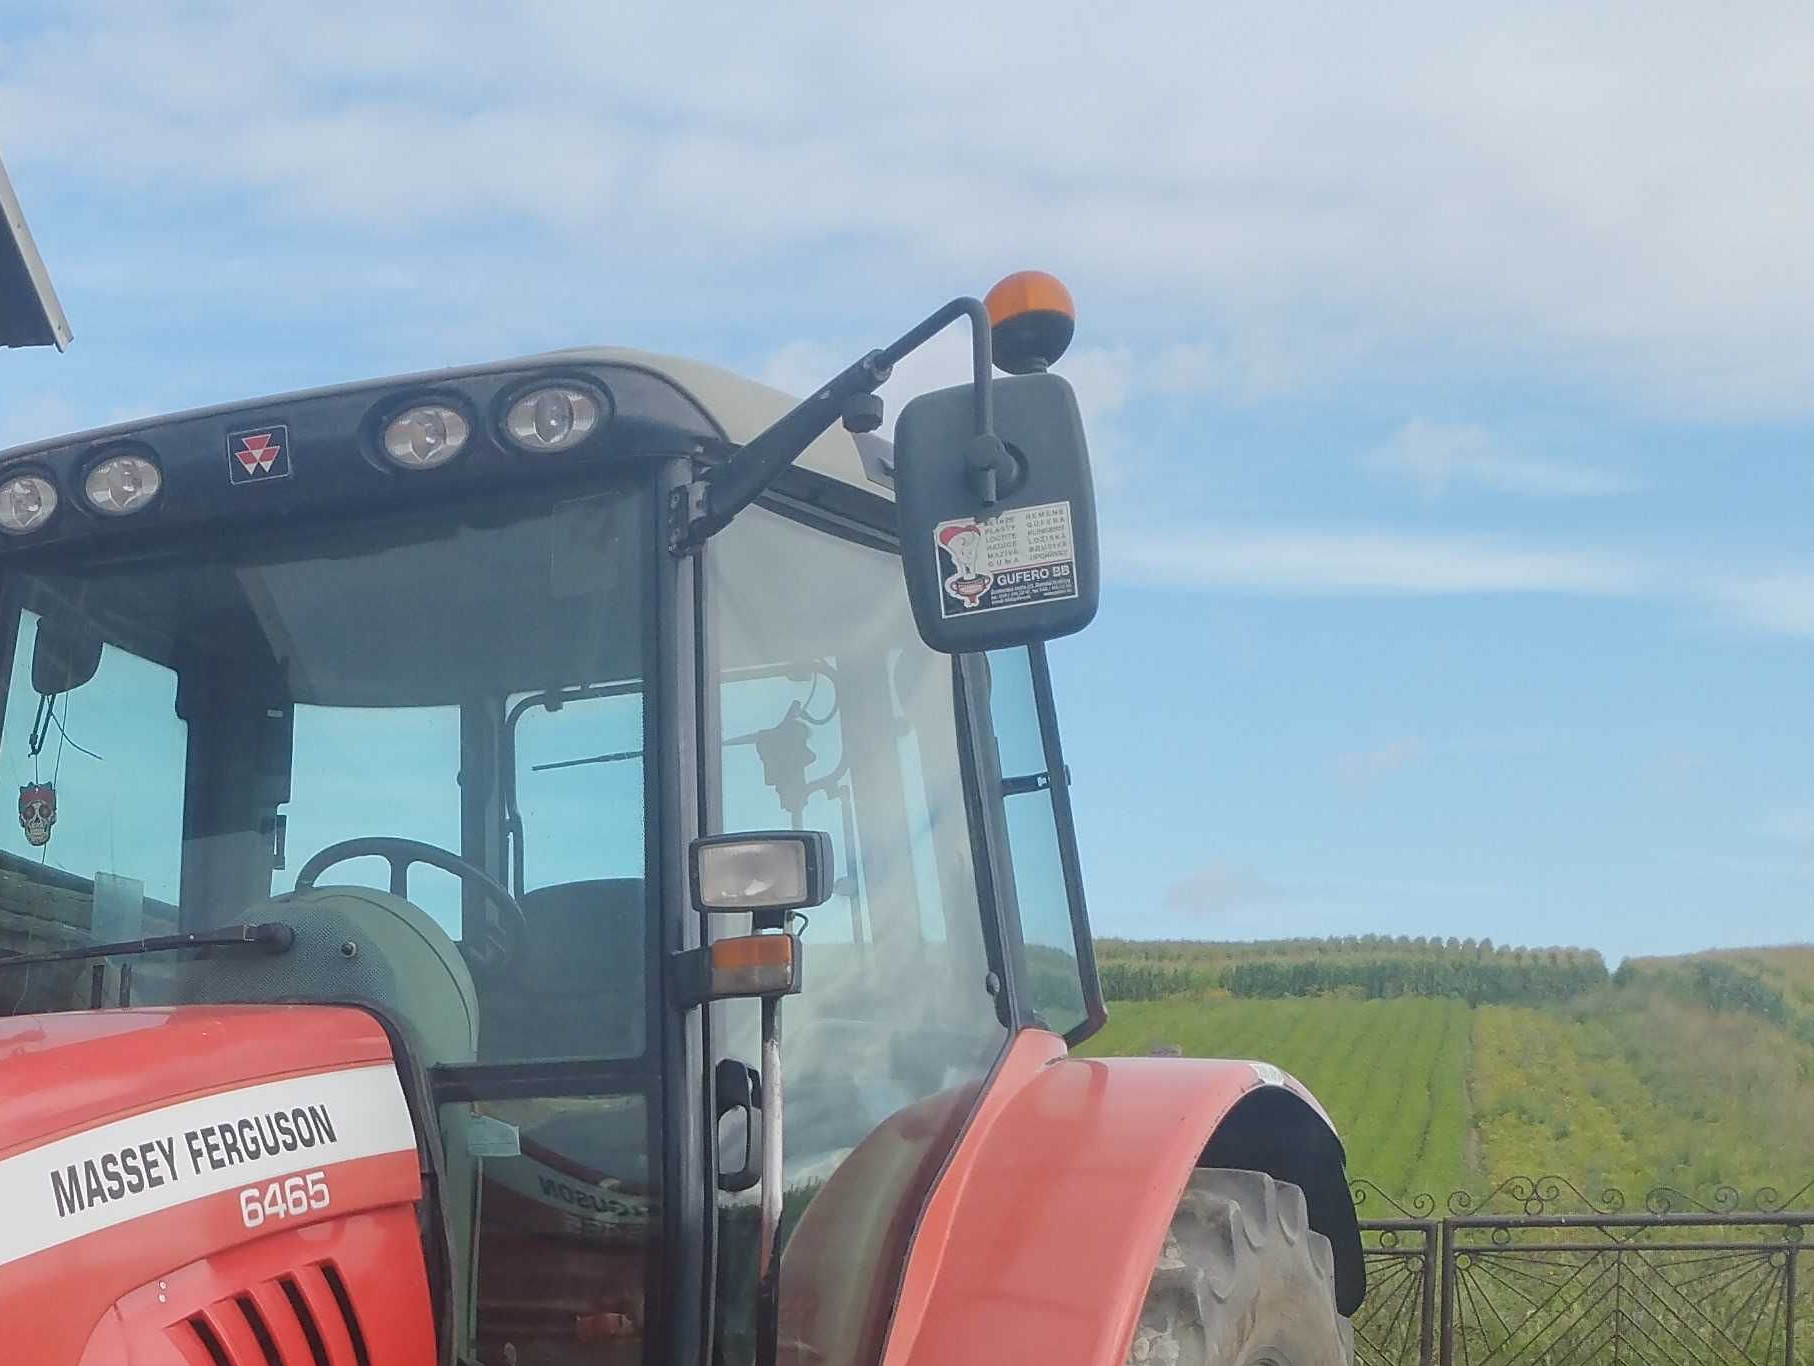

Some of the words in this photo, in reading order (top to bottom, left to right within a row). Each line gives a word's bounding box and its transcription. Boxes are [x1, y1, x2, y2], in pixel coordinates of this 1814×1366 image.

[997, 566, 1050, 586] GUFERO
[1052, 564, 1071, 577] BB
[50, 1136, 179, 1219] MASSEY
[184, 1103, 338, 1175] FERGUSON
[239, 1171, 330, 1228] 6465
